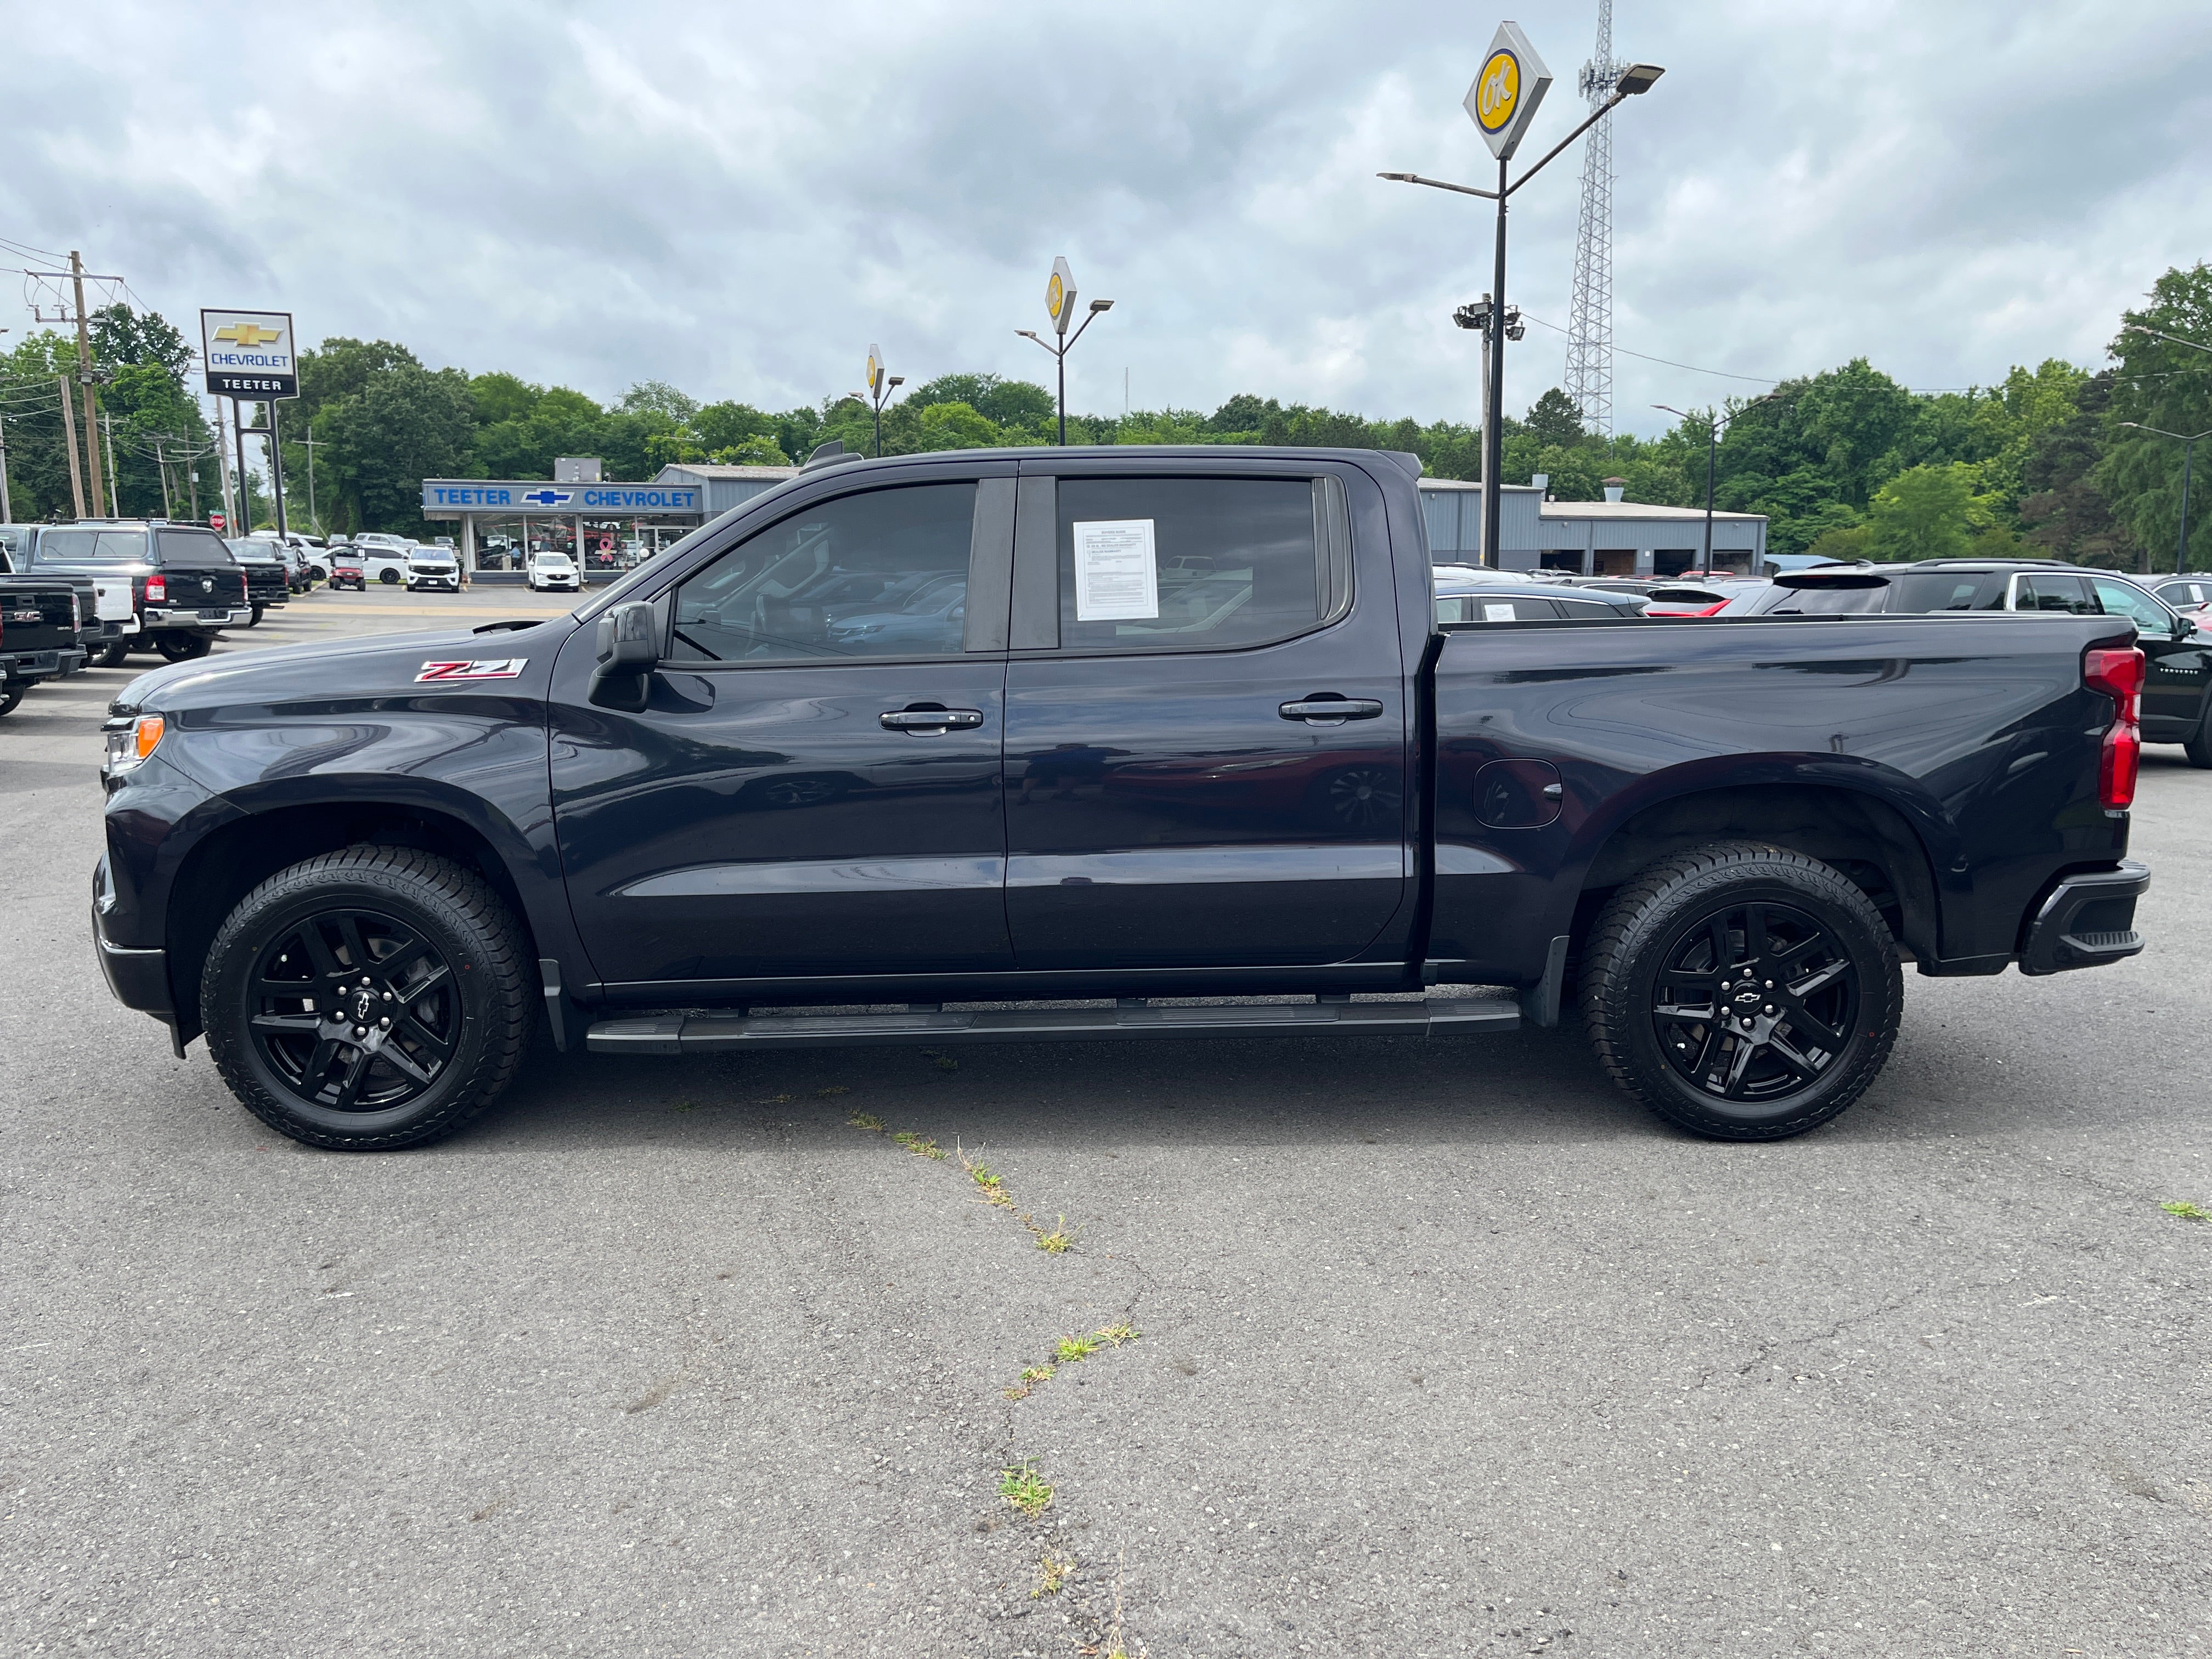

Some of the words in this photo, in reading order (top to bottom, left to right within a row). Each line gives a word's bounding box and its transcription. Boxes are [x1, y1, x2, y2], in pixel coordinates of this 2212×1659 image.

[1482, 60, 1512, 116] OK
[212, 353, 289, 366] CHEVROLET
[222, 379, 281, 391] TEETER
[434, 489, 510, 504] TEETER
[584, 491, 694, 506] CHEVROLET
[14, 611, 40, 621] GMC
[414, 658, 530, 683] Z71
